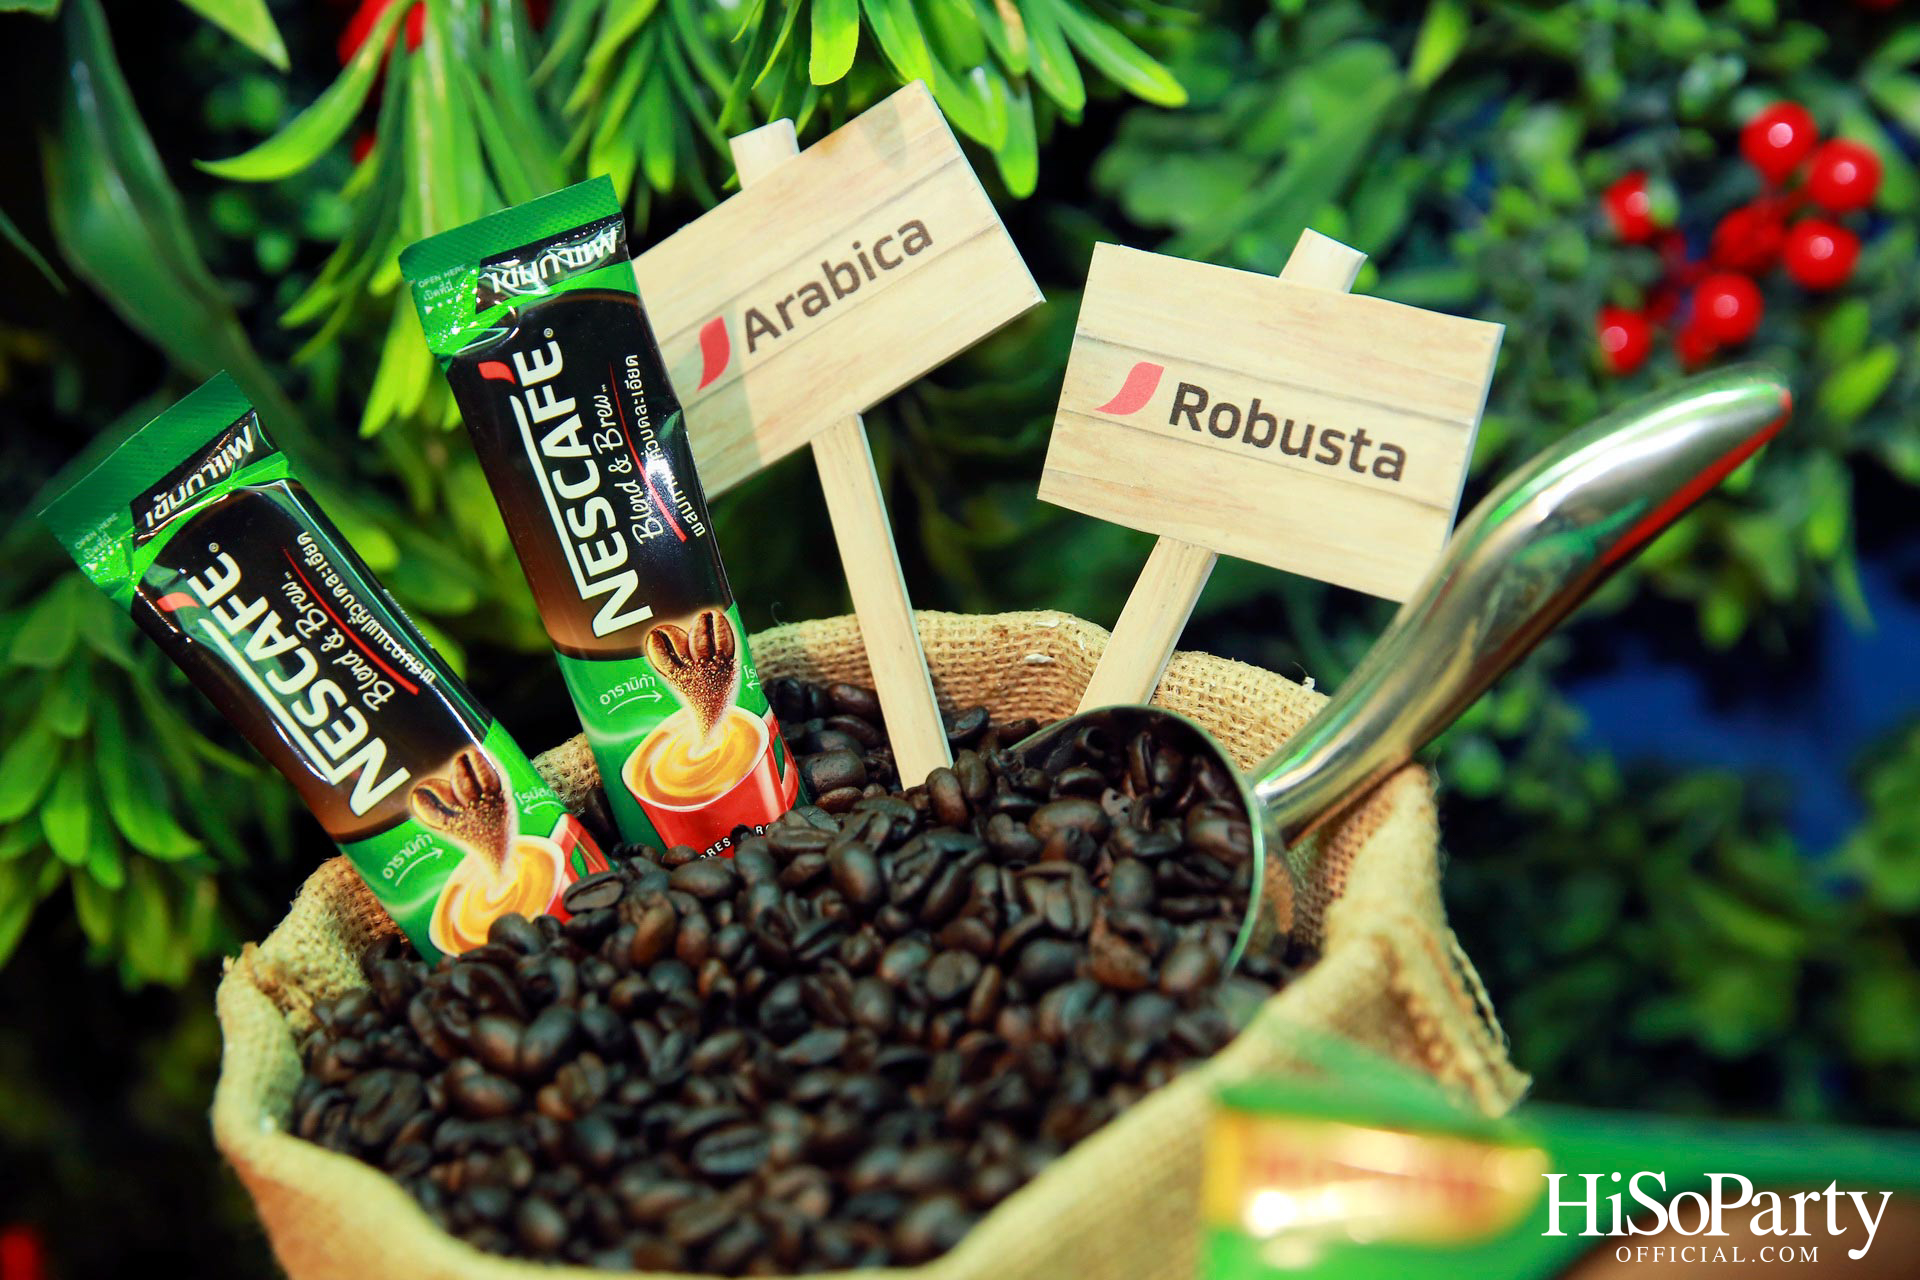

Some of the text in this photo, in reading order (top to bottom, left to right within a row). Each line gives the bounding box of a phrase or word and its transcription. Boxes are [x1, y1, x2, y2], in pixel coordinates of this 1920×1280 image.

[745, 219, 933, 354] Arabica
[608, 453, 633, 474] &
[1168, 382, 1408, 482] Robusta
[144, 425, 255, 528] เข้มกาแฟ
[614, 479, 664, 545] Blend
[320, 629, 346, 653] &
[331, 651, 396, 712] Blend
[600, 673, 656, 706] อาราบิก้า
